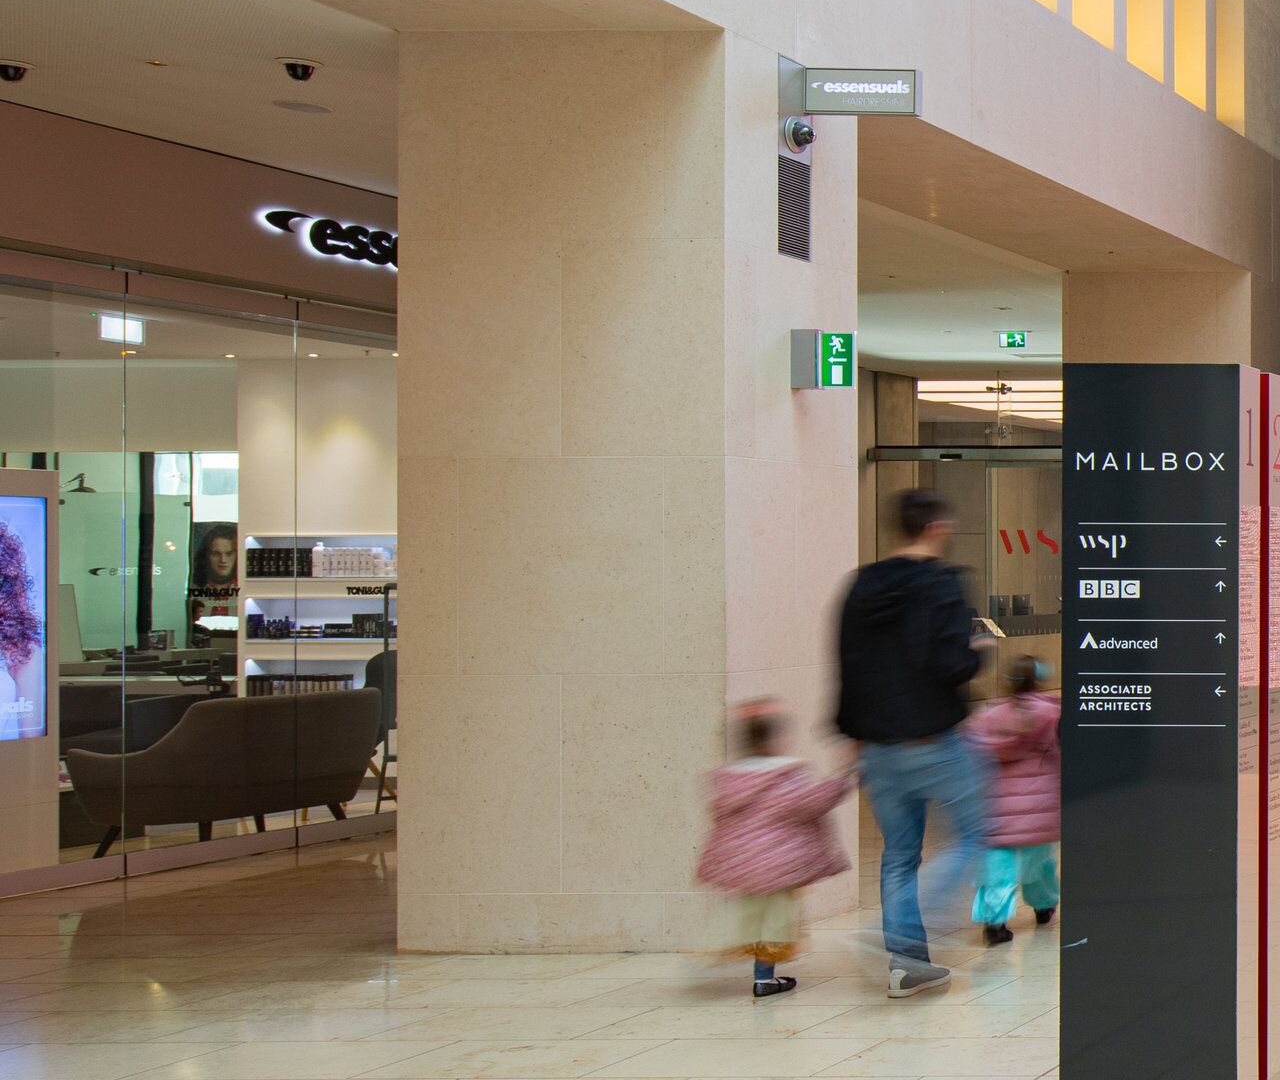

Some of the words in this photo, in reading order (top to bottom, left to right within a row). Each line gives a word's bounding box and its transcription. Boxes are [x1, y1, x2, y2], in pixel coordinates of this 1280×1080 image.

[823, 79, 910, 94] essensuals
[309, 219, 398, 266] ess
[1076, 451, 1225, 471] MAILBOX
[188, 588, 240, 598] TONI&GUY
[1082, 582, 1138, 597] BBC
[1099, 637, 1158, 649] advanced
[1079, 685, 1152, 694] ASSOCIATED
[1079, 702, 1152, 711] ARCHITECTS
